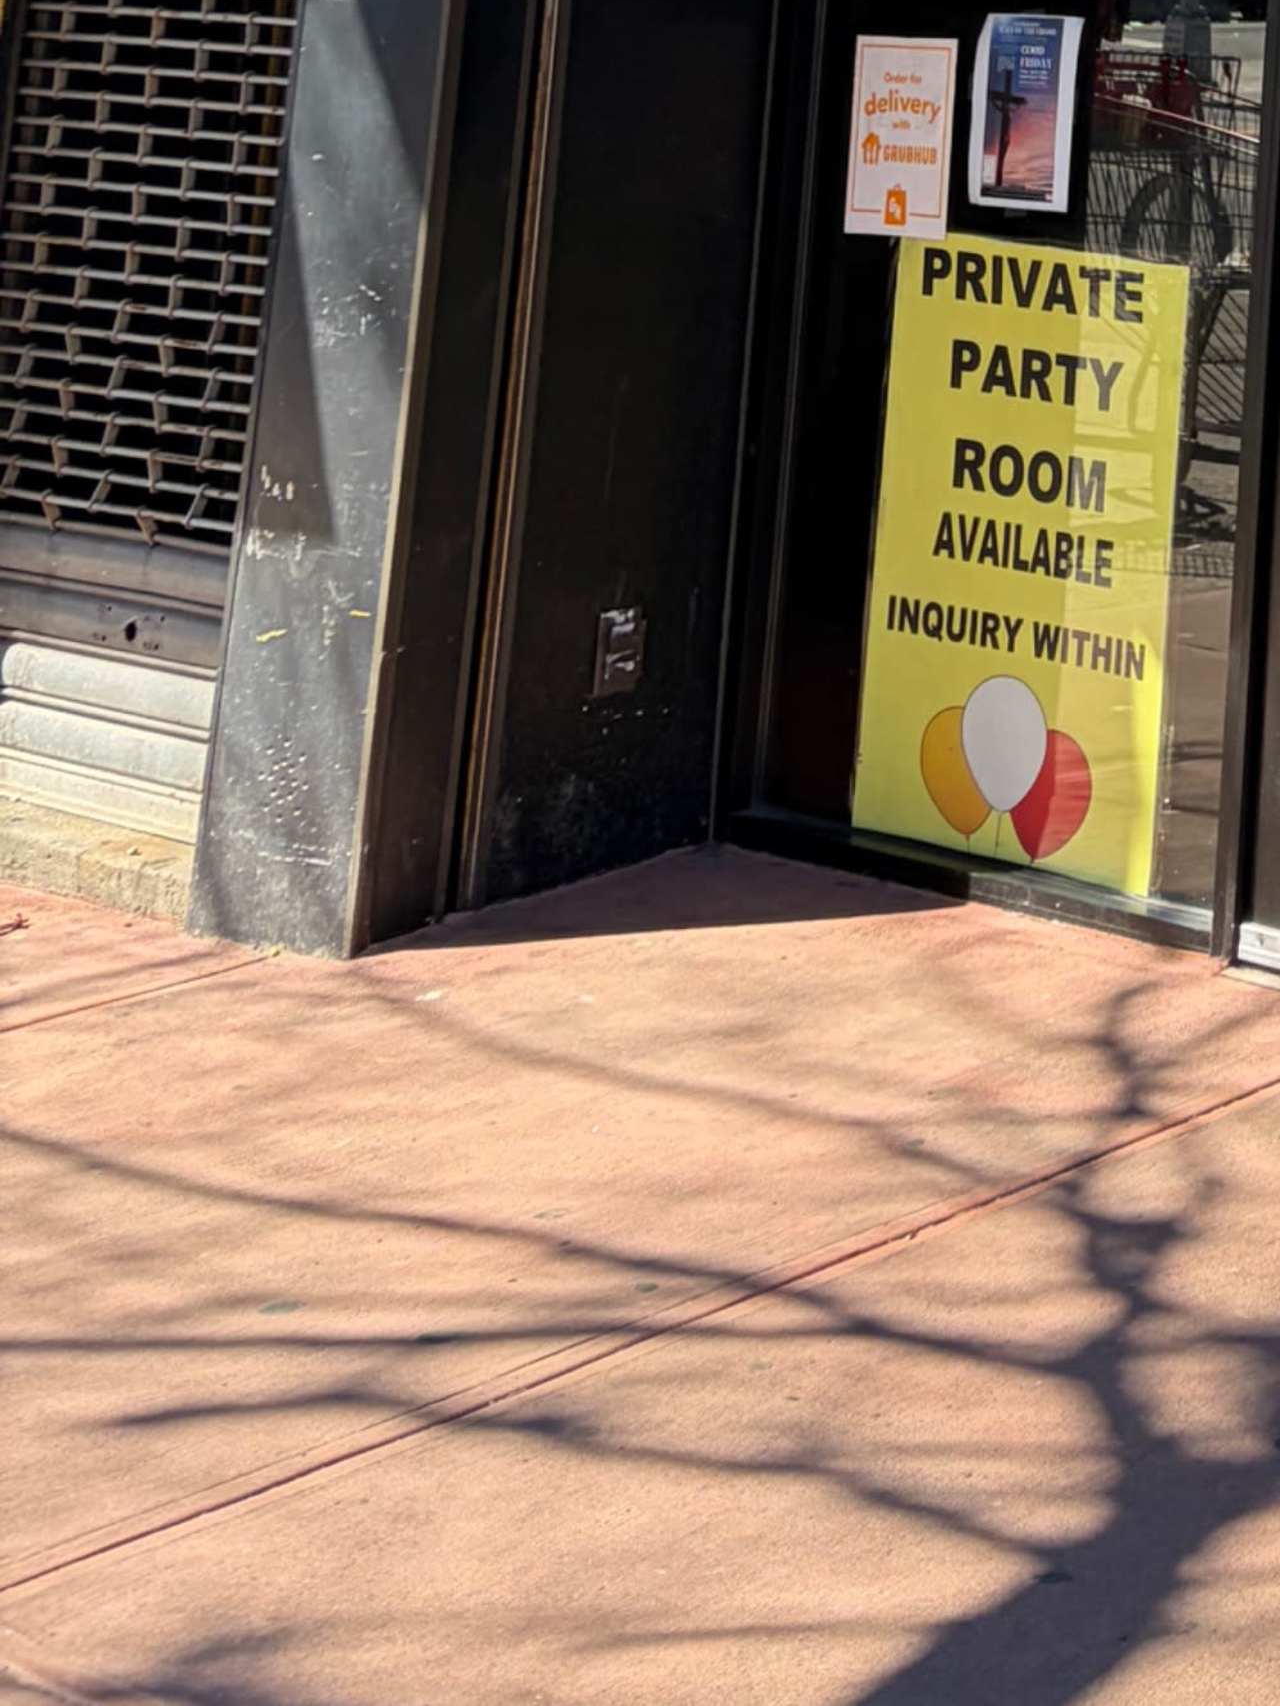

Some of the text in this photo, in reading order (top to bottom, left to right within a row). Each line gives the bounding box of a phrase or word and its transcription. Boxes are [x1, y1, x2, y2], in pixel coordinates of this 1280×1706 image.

[863, 88, 942, 124] delivery
[883, 70, 923, 85] Order for
[882, 144, 938, 166] GRUBHUB
[920, 246, 1145, 325] PRIVATE
[949, 339, 1125, 413] PARTY
[951, 437, 1108, 514] ROOM
[931, 511, 1115, 589] AVAILABLE
[885, 594, 1146, 681] INQUIRY WITHIN
